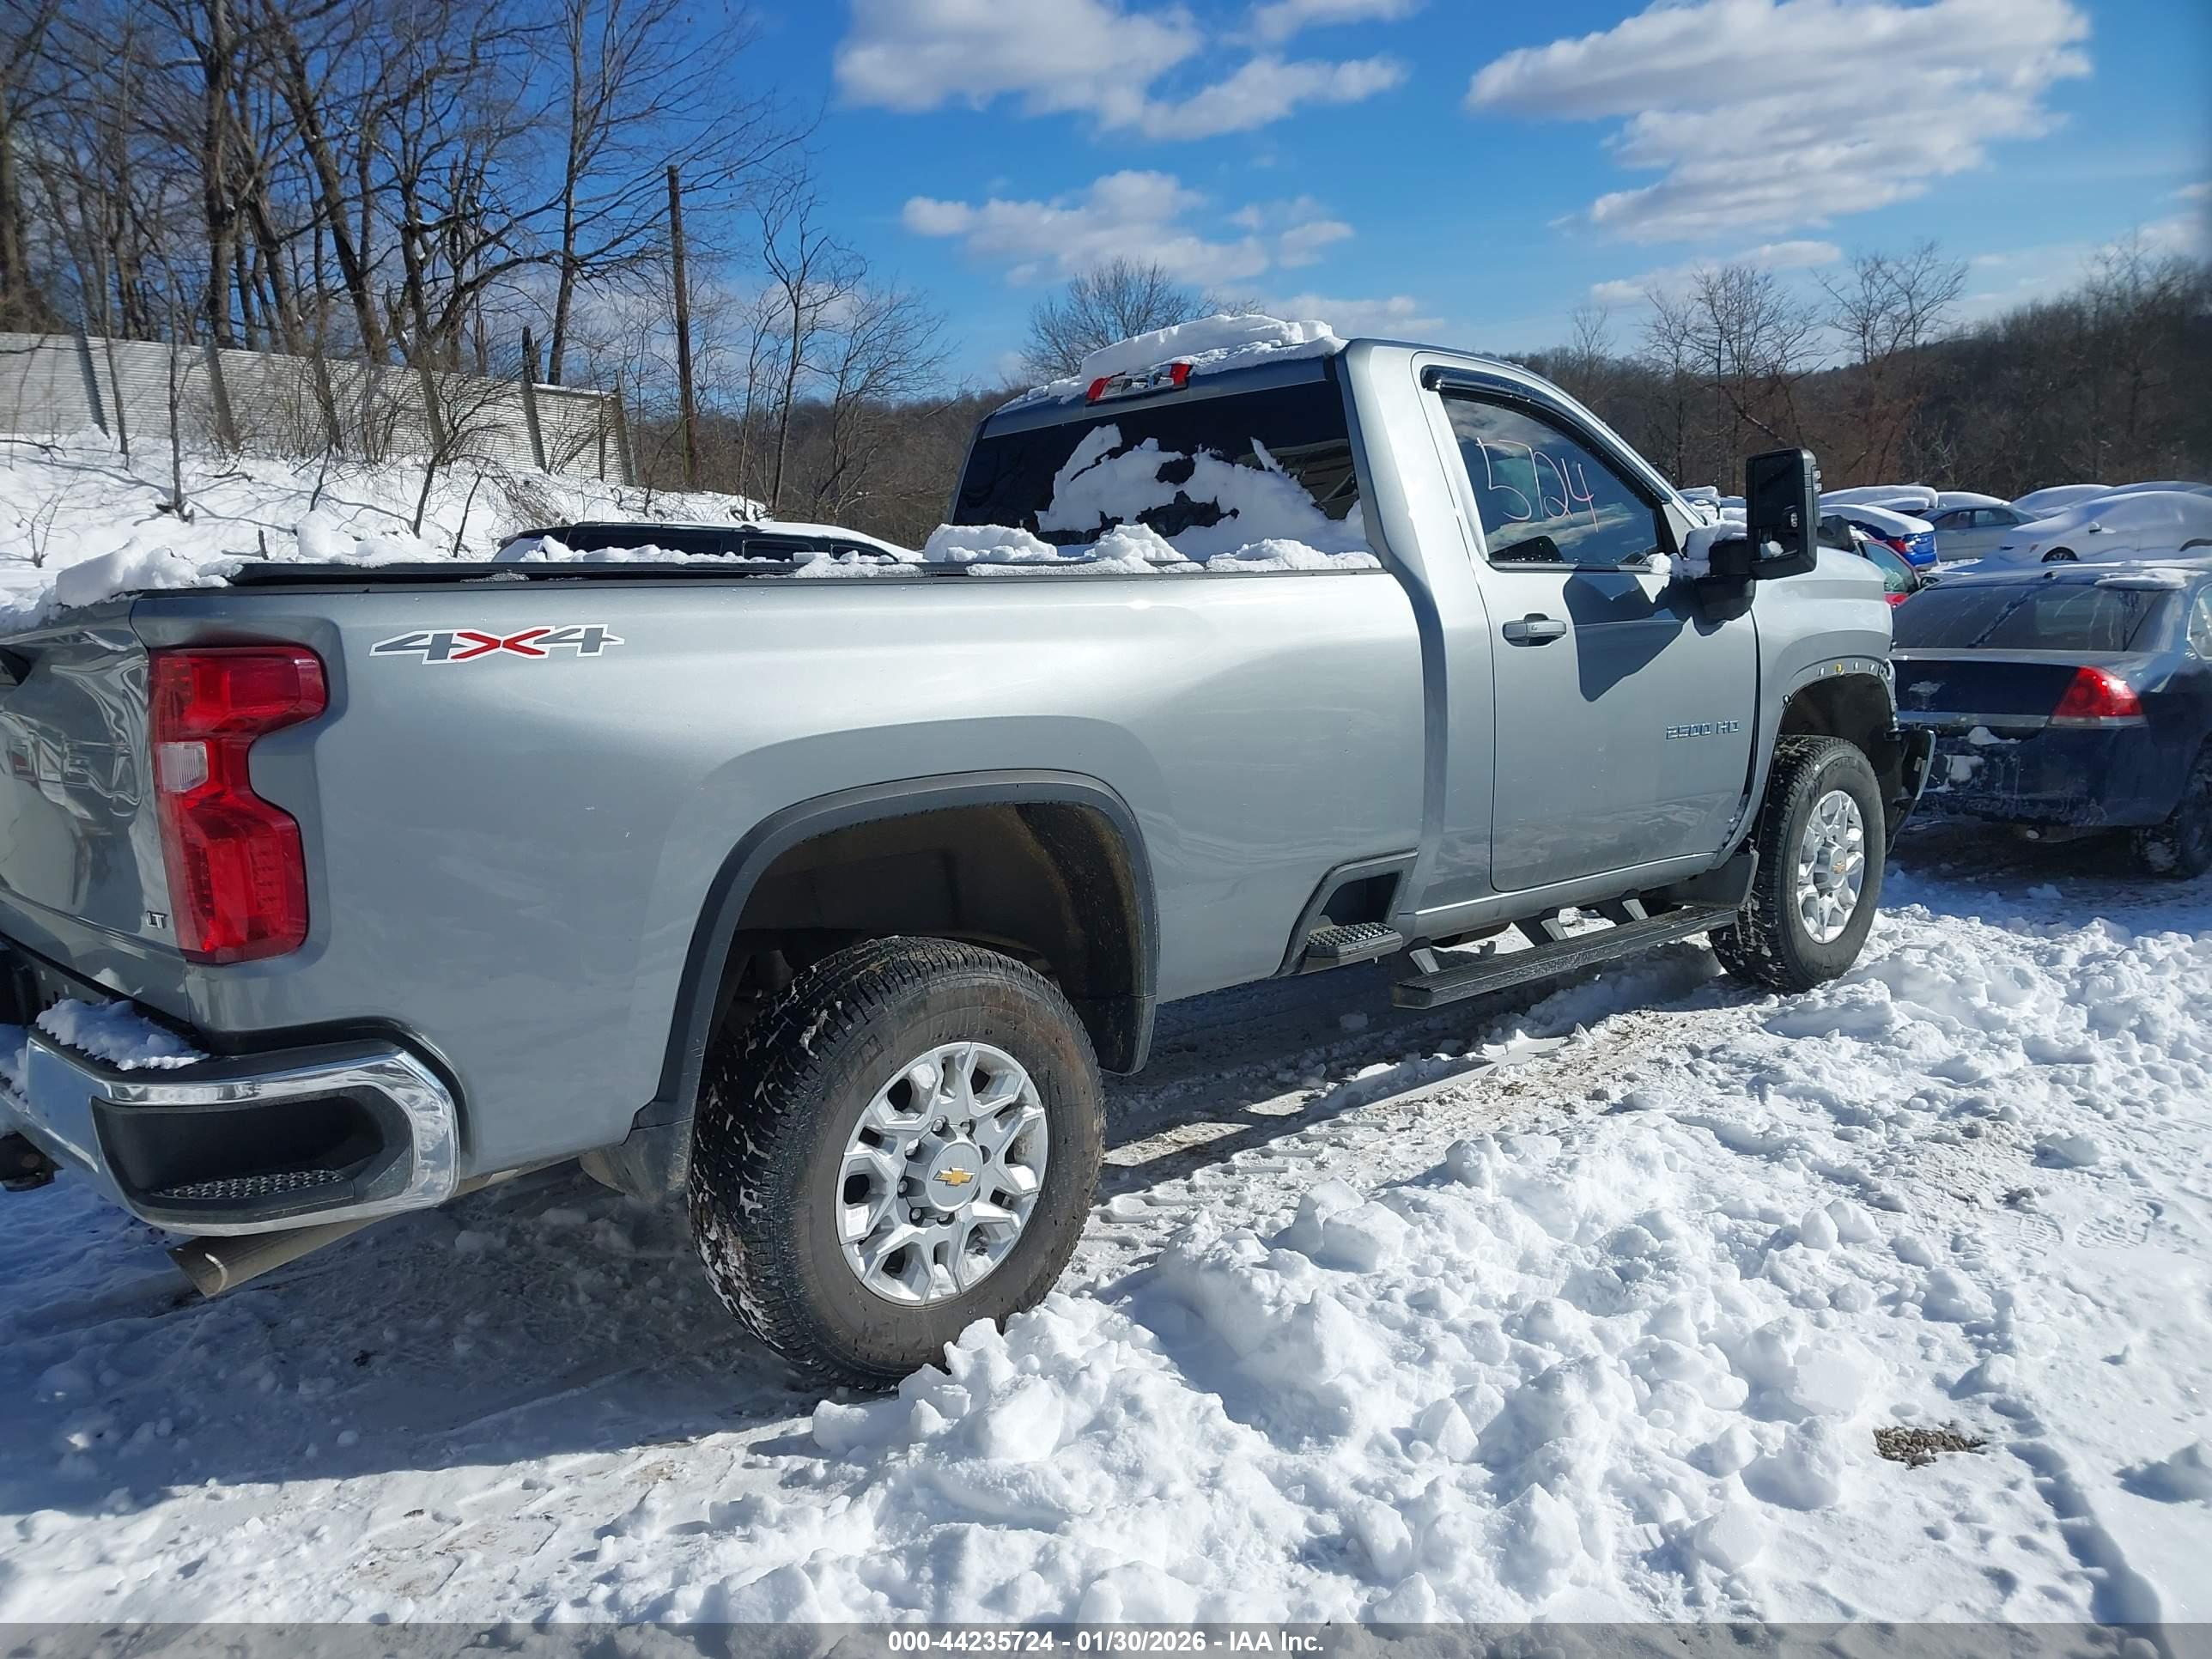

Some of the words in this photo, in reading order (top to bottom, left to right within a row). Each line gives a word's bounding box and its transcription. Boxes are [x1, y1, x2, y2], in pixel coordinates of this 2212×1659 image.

[1666, 723, 1711, 739] 2500
[1716, 720, 1739, 734] HD
[146, 911, 167, 928] LT
